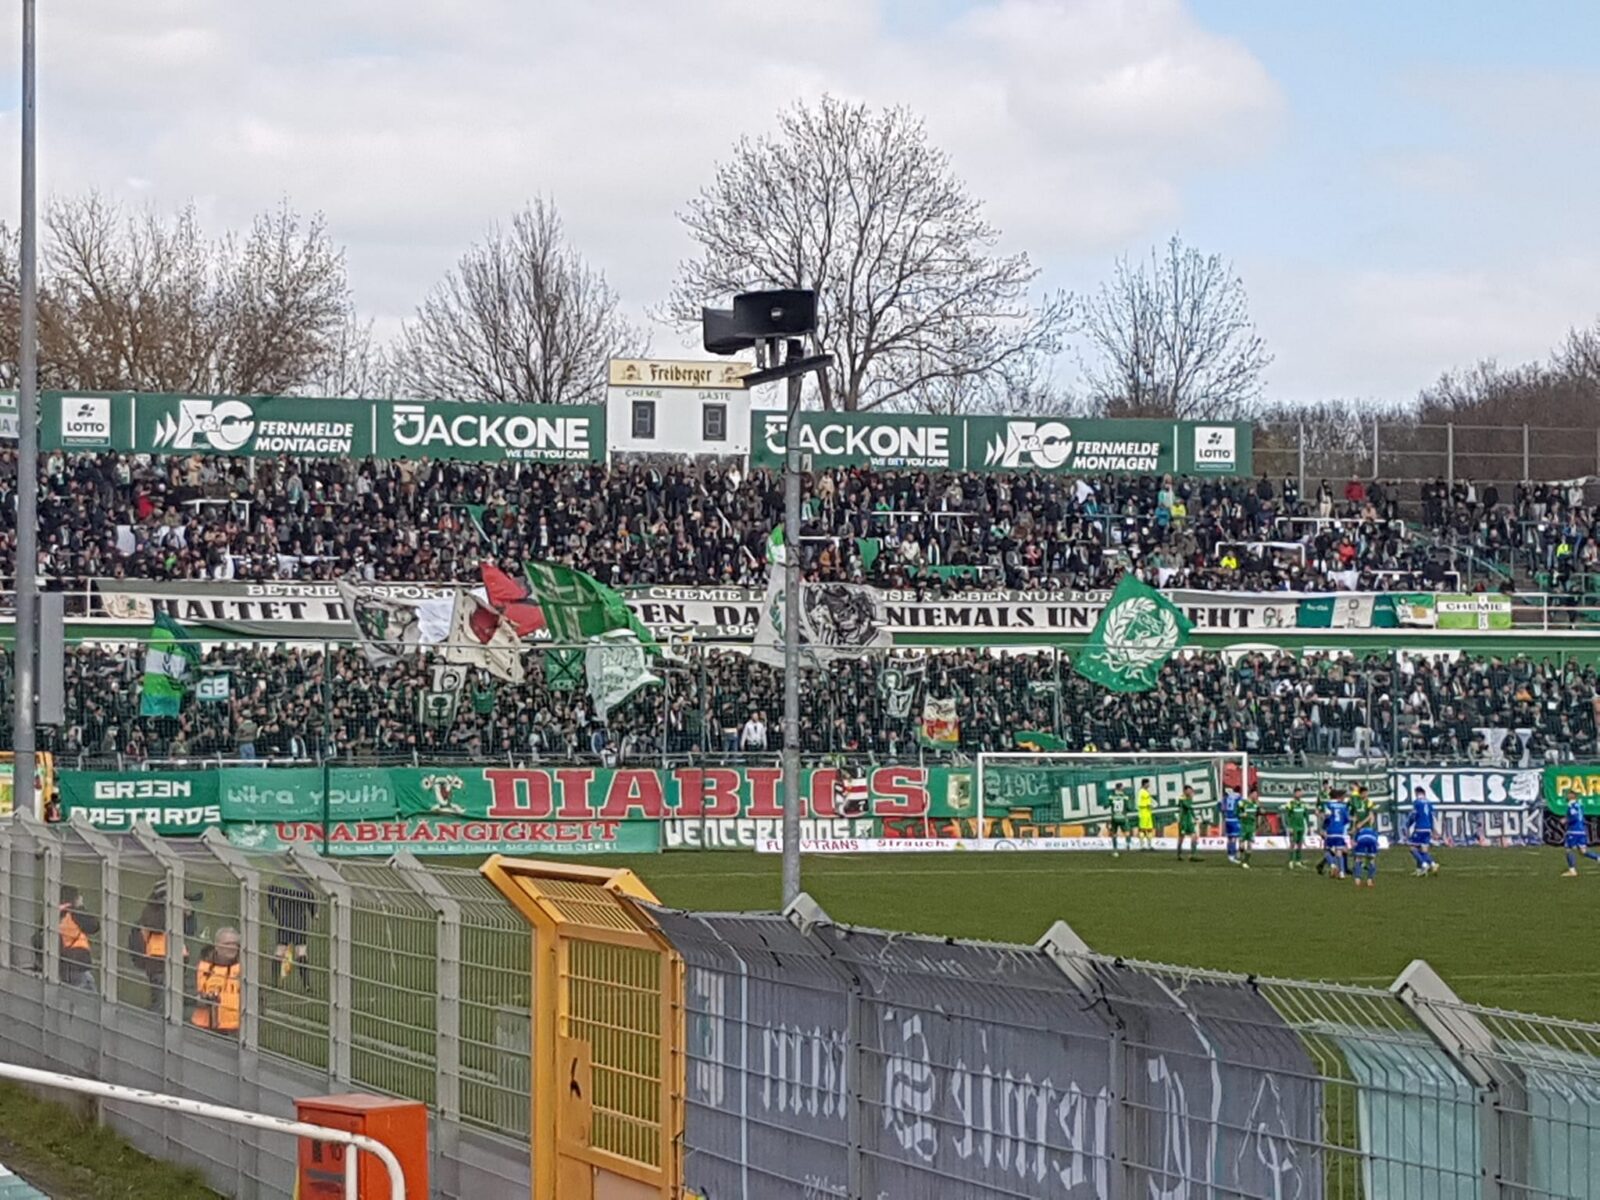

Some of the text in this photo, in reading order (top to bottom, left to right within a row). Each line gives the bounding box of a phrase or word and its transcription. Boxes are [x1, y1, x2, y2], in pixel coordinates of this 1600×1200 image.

[649, 364, 712, 386] Freiberger
[67, 422, 105, 432] LOTTO
[258, 421, 354, 437] FERNMELDE
[393, 405, 590, 448] JACKONE
[254, 438, 352, 453] MONTAGEN
[1075, 441, 1160, 456] FERNMELDE
[1199, 450, 1230, 459] LOTTO
[1072, 456, 1158, 470] MONTAGEN
[649, 588, 741, 601] CHEMIE
[1018, 591, 1066, 601] NUR
[886, 606, 1032, 627] NIEMALS
[276, 819, 621, 843] UNABHÄNGIGKEIT
